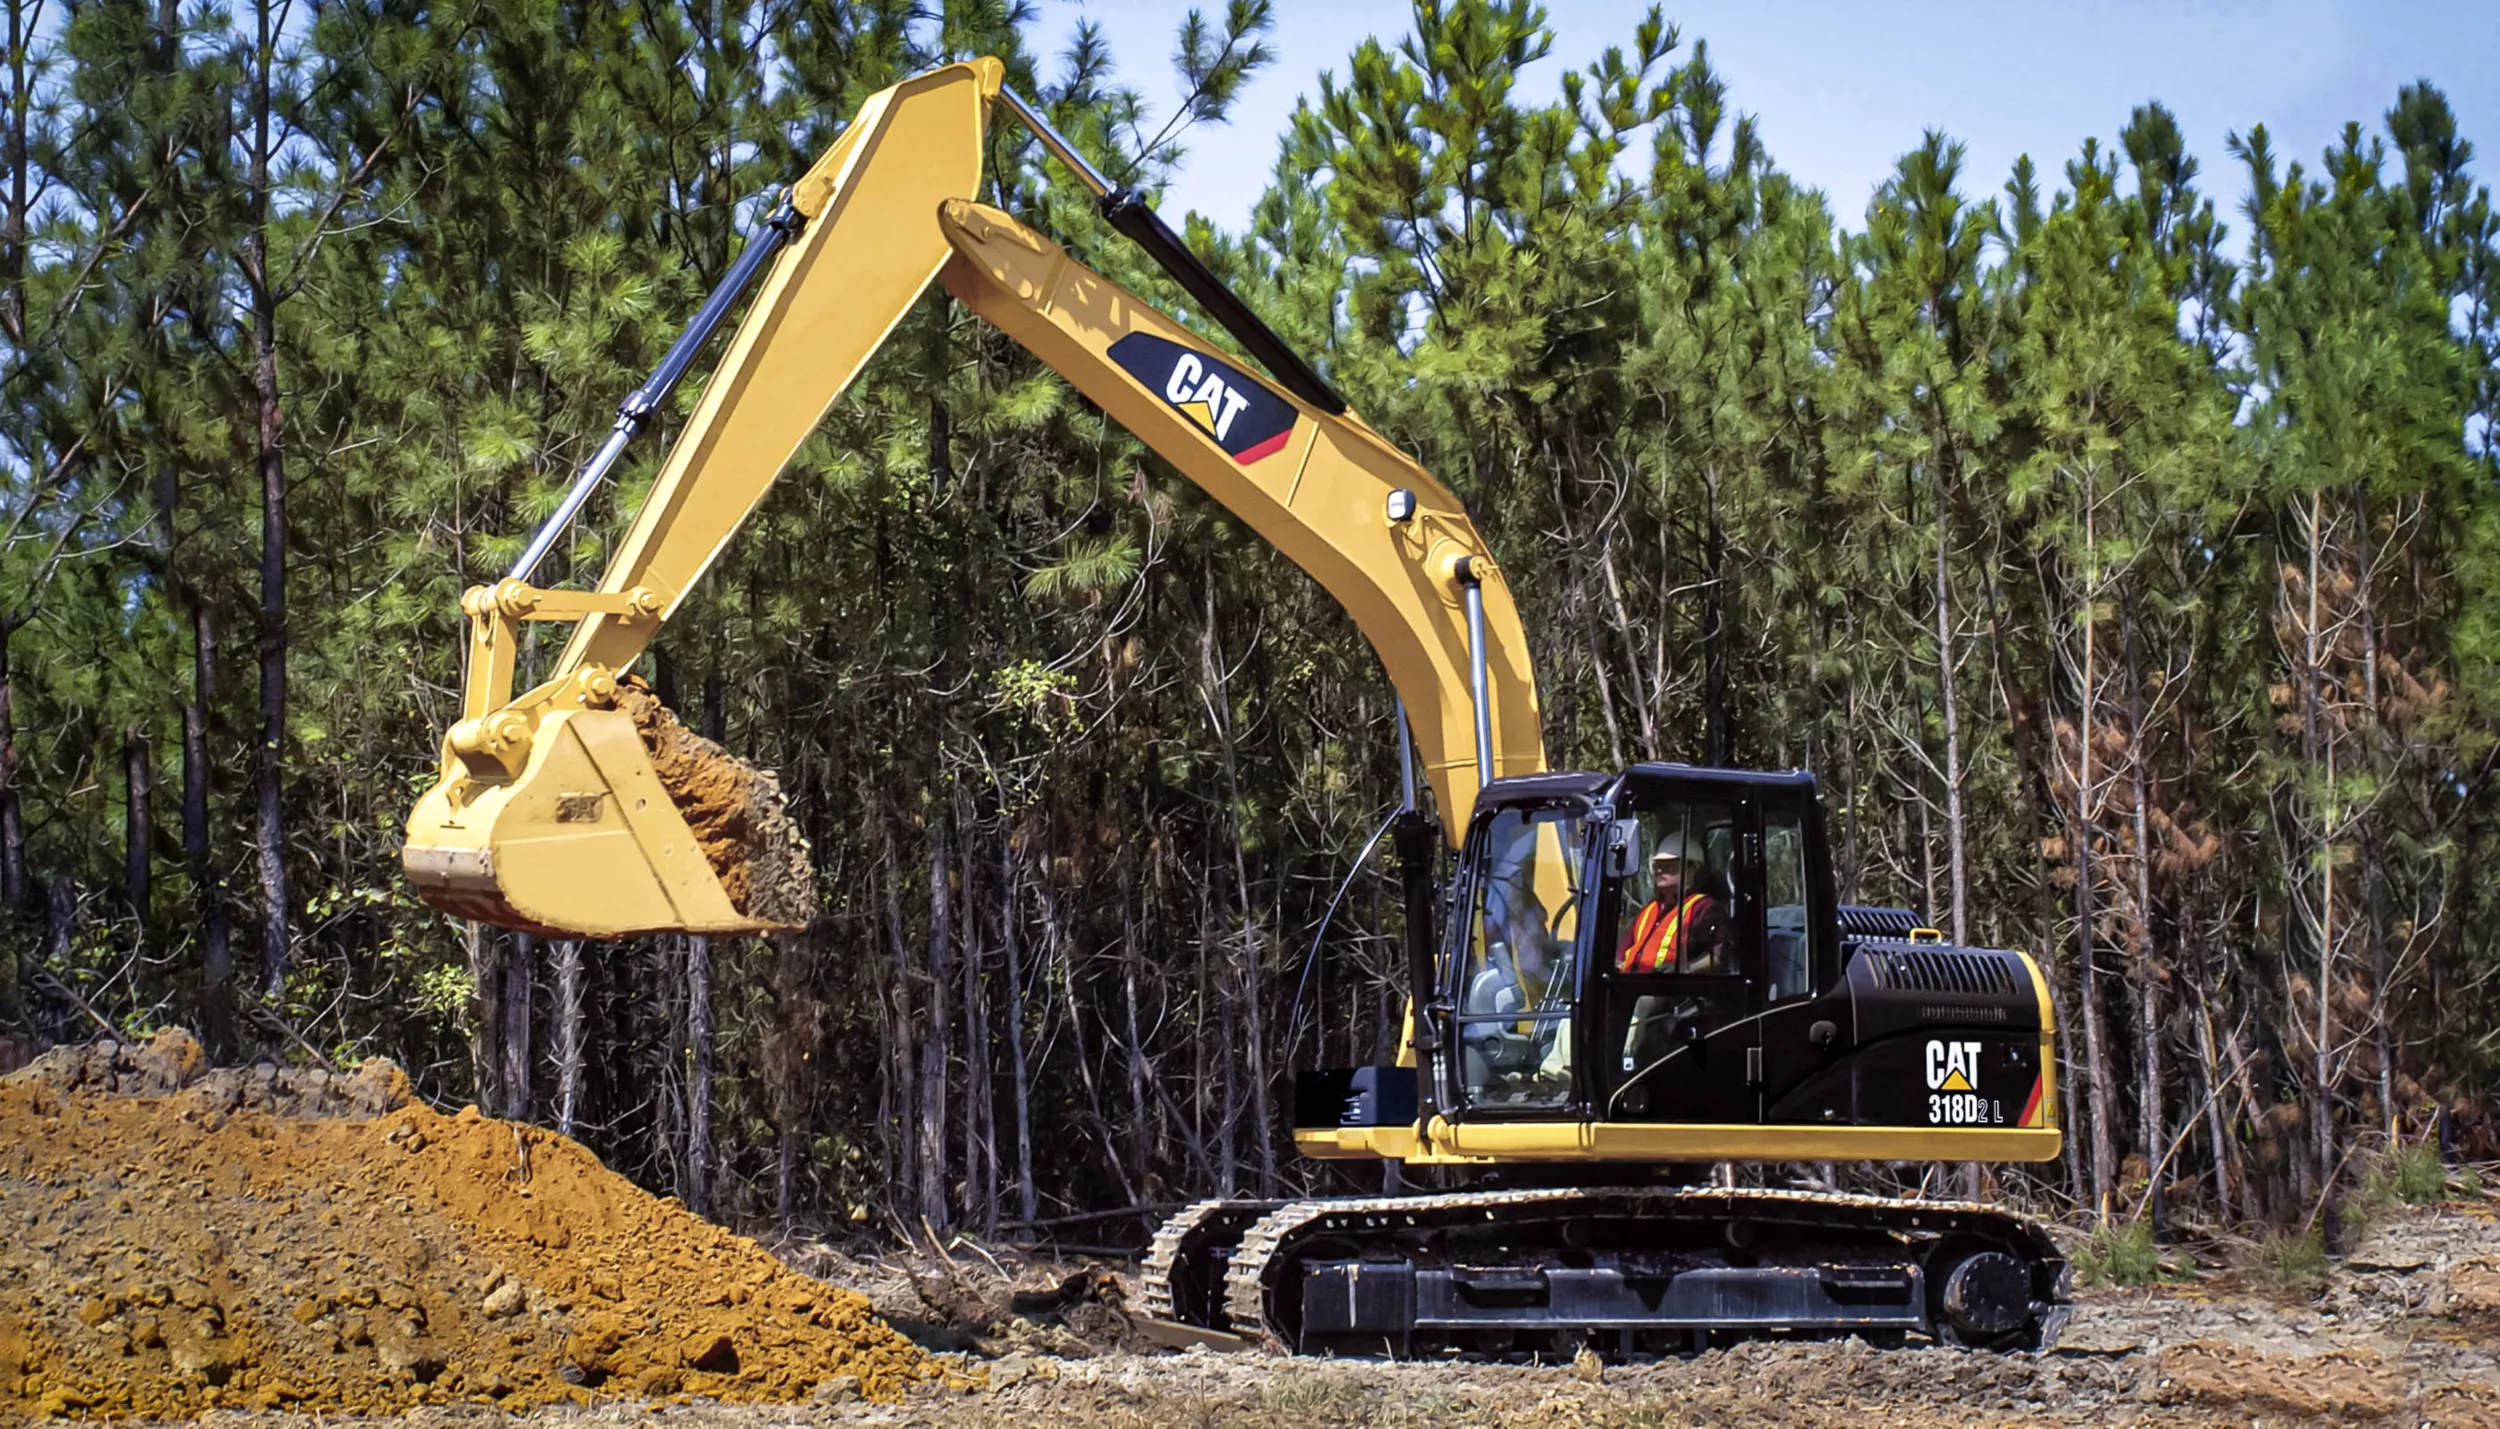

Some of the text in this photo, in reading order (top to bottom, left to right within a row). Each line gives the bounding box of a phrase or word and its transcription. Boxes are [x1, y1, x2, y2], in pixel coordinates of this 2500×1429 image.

[1166, 353, 1249, 442] CAT
[1925, 1039, 1982, 1091] CAT
[1928, 1093, 2004, 1124] 318D2 L
